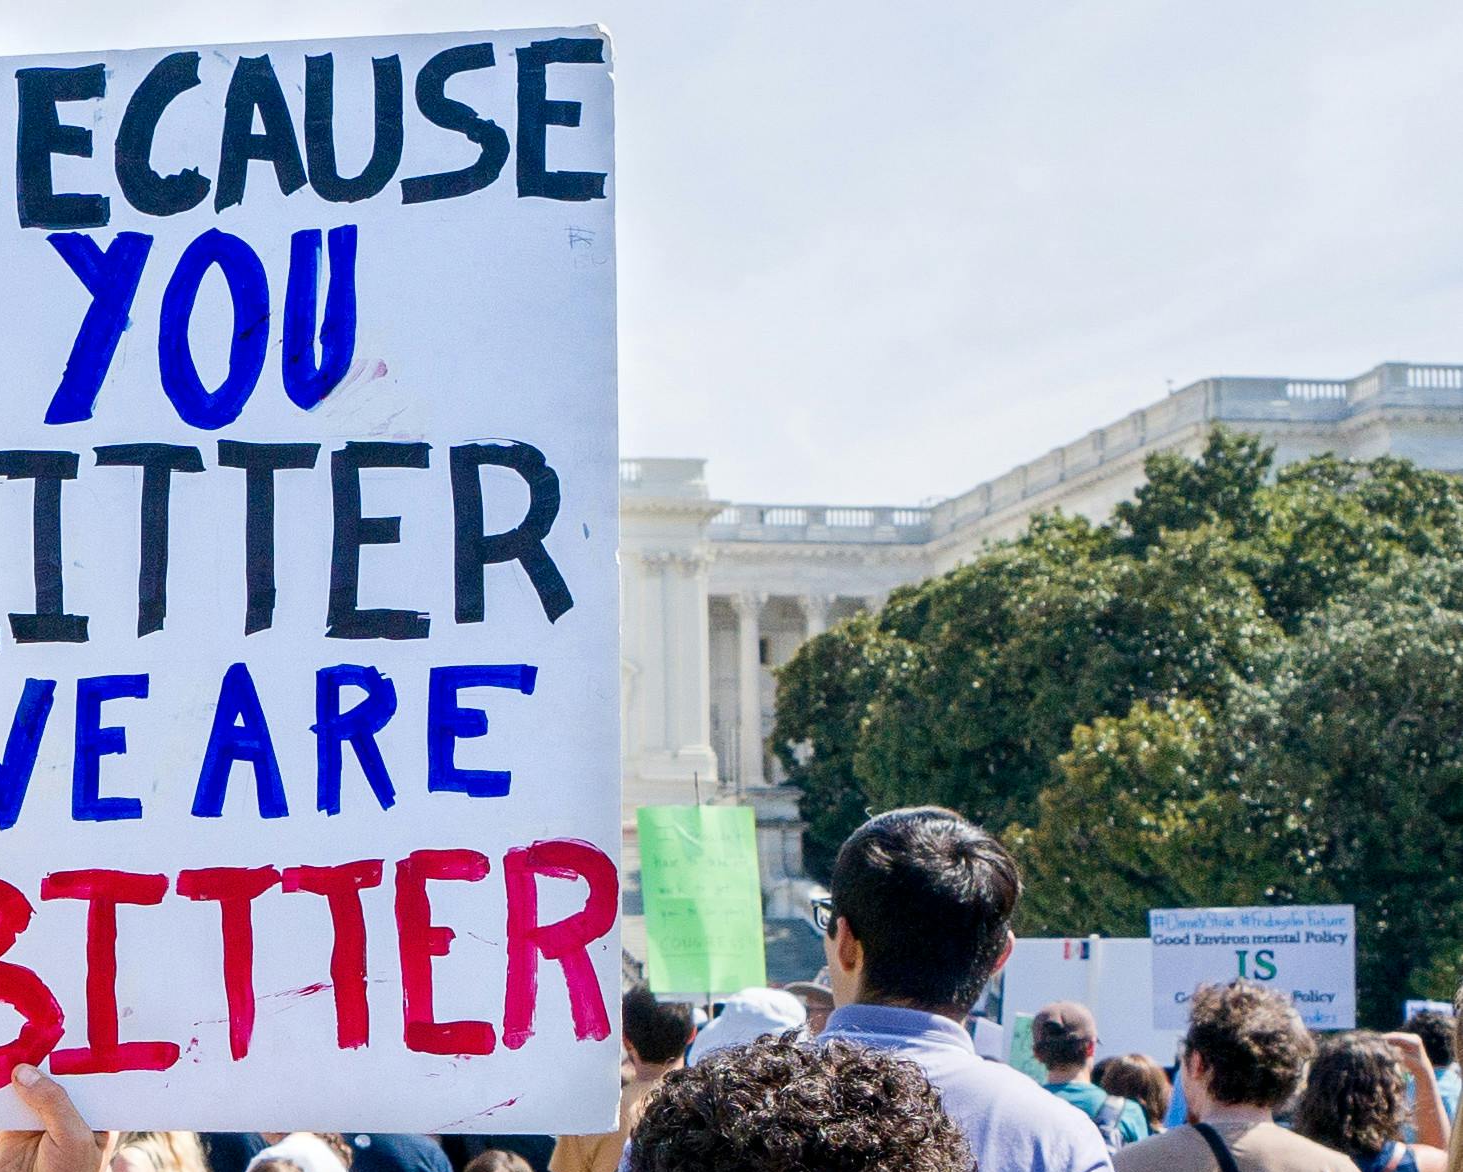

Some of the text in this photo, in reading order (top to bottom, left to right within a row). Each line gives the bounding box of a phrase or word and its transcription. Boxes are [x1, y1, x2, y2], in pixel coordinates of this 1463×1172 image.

[43, 224, 358, 430] YOU
[190, 662, 538, 820] ARE
[1152, 933, 1191, 945] Good
[1305, 930, 1348, 946] Policy
[1235, 950, 1278, 981] IS
[1292, 989, 1337, 1003] Policy
